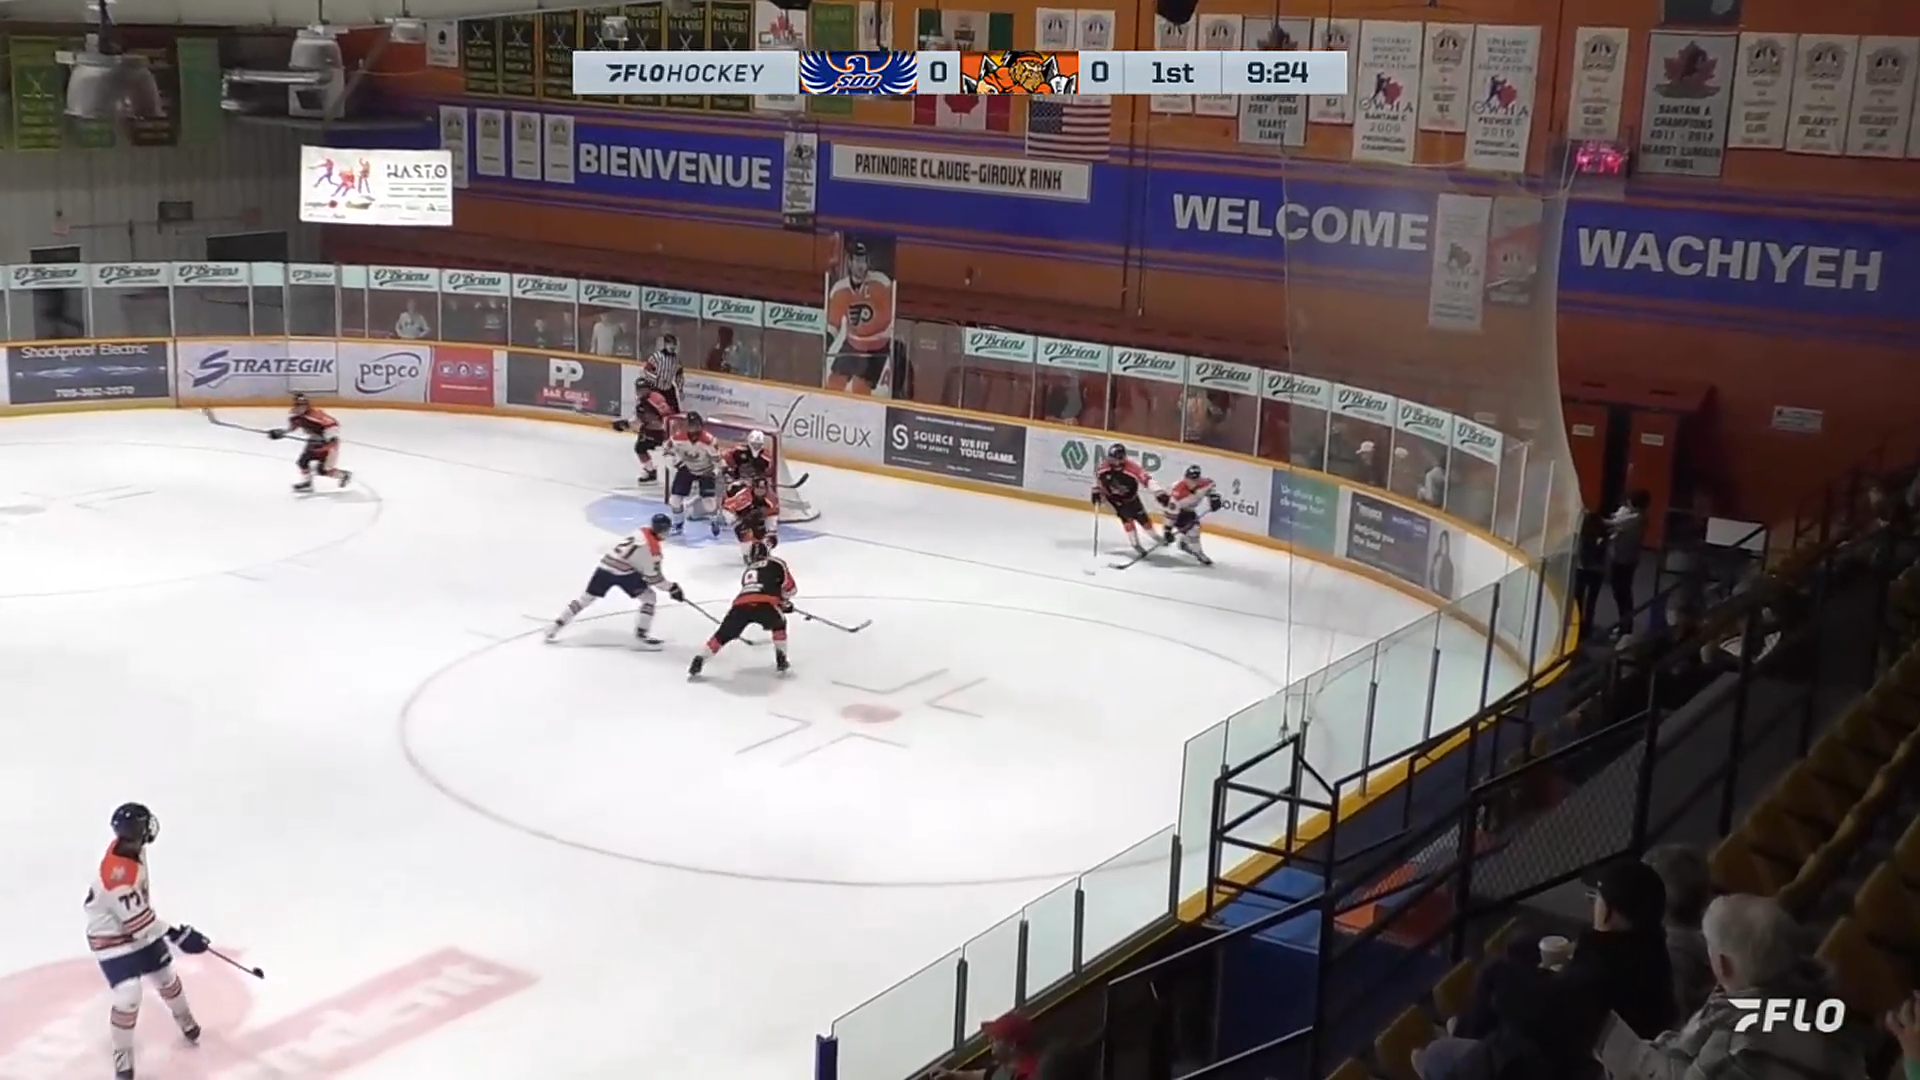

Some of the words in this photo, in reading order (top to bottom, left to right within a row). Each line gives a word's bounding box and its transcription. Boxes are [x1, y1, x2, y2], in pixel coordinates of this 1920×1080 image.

[579, 143, 771, 190] BIENVENUE
[854, 153, 917, 179] PATINOIRE
[920, 158, 1027, 189] CLAUDE-GIROUX
[1029, 168, 1063, 191] RINK
[1173, 193, 1429, 251] WELCOME
[1578, 227, 1883, 291] WACHIYEH
[970, 332, 1026, 350] O'Briens
[1043, 341, 1101, 360] O'Briens
[193, 350, 334, 387] STRATEGIK
[1117, 350, 1176, 369] O'Briens
[359, 362, 420, 385] pepco
[1196, 361, 1252, 382] O'Briens
[913, 430, 954, 446] SOURCE
